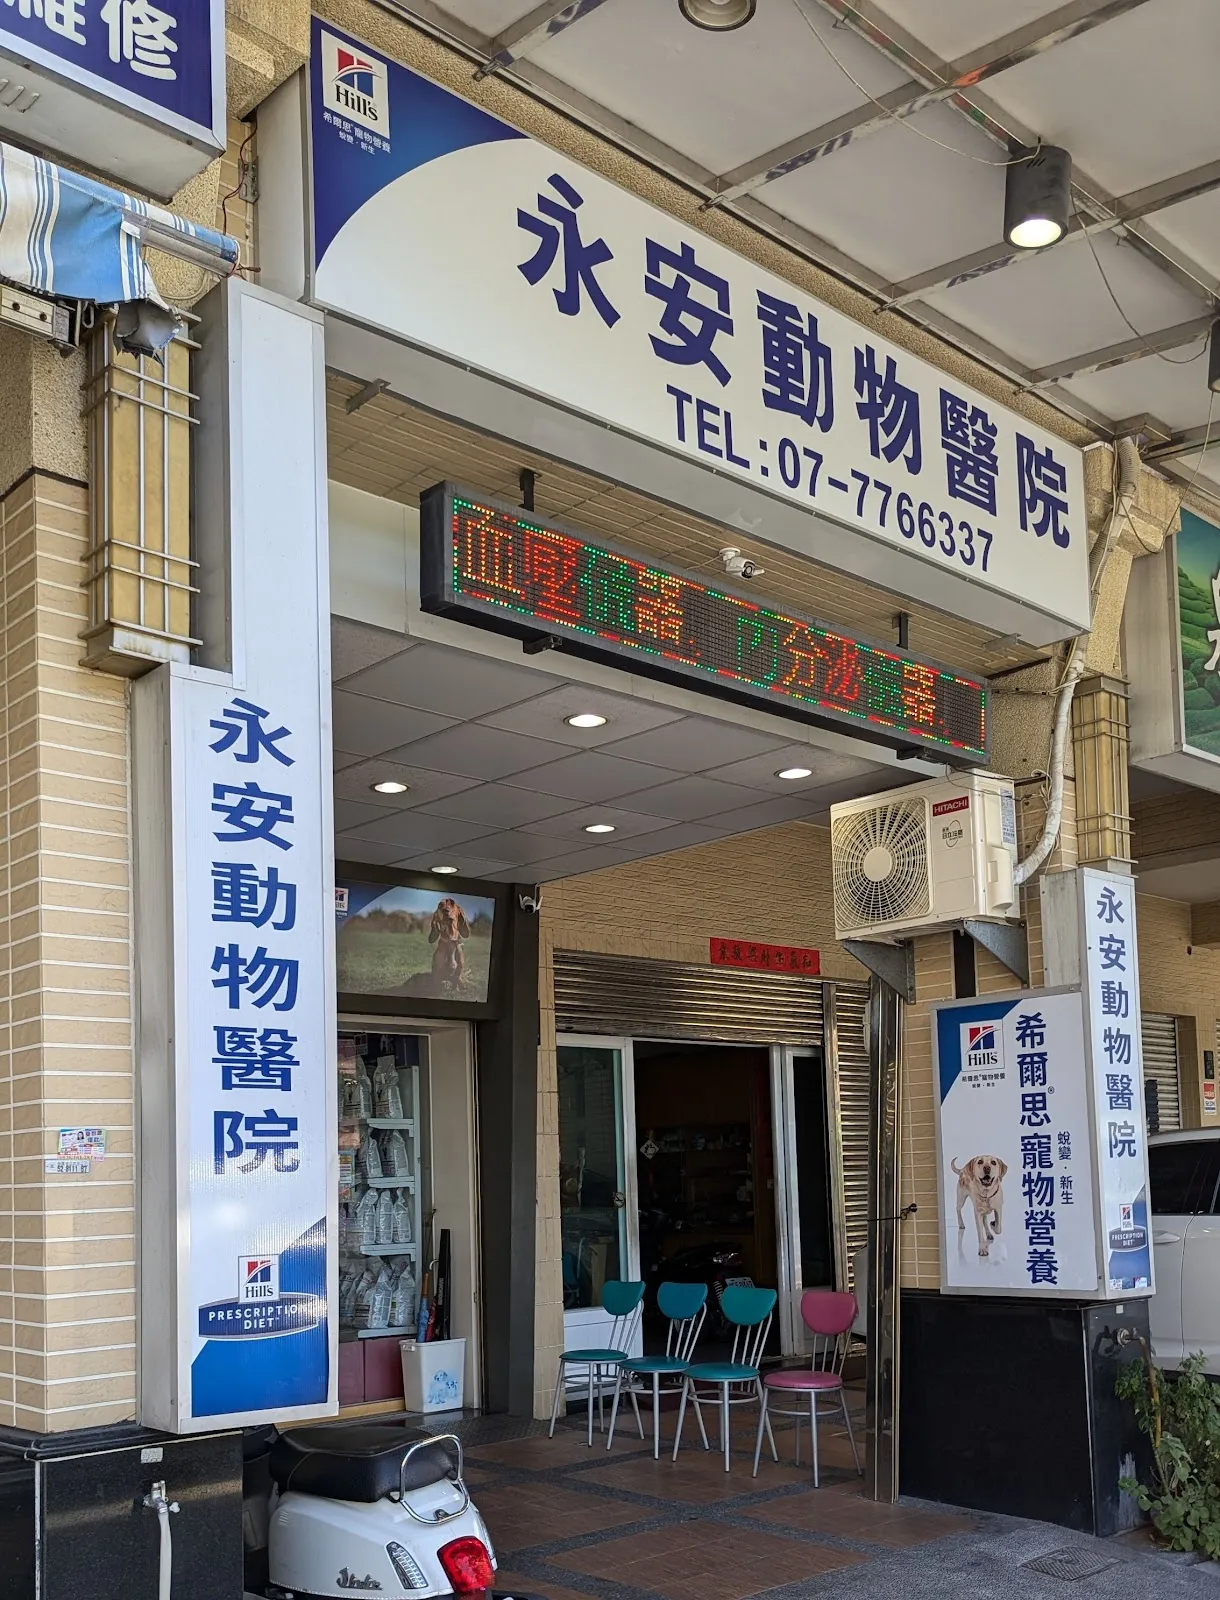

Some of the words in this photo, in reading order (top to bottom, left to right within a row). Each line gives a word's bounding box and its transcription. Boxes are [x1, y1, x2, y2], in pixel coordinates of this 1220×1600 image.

[517, 173, 1070, 548] 永安動物醫院
[208, 697, 300, 1175] 永安動物醫院
[934, 799, 968, 814] HITACHI
[1097, 886, 1137, 1158] 永安動物醫院
